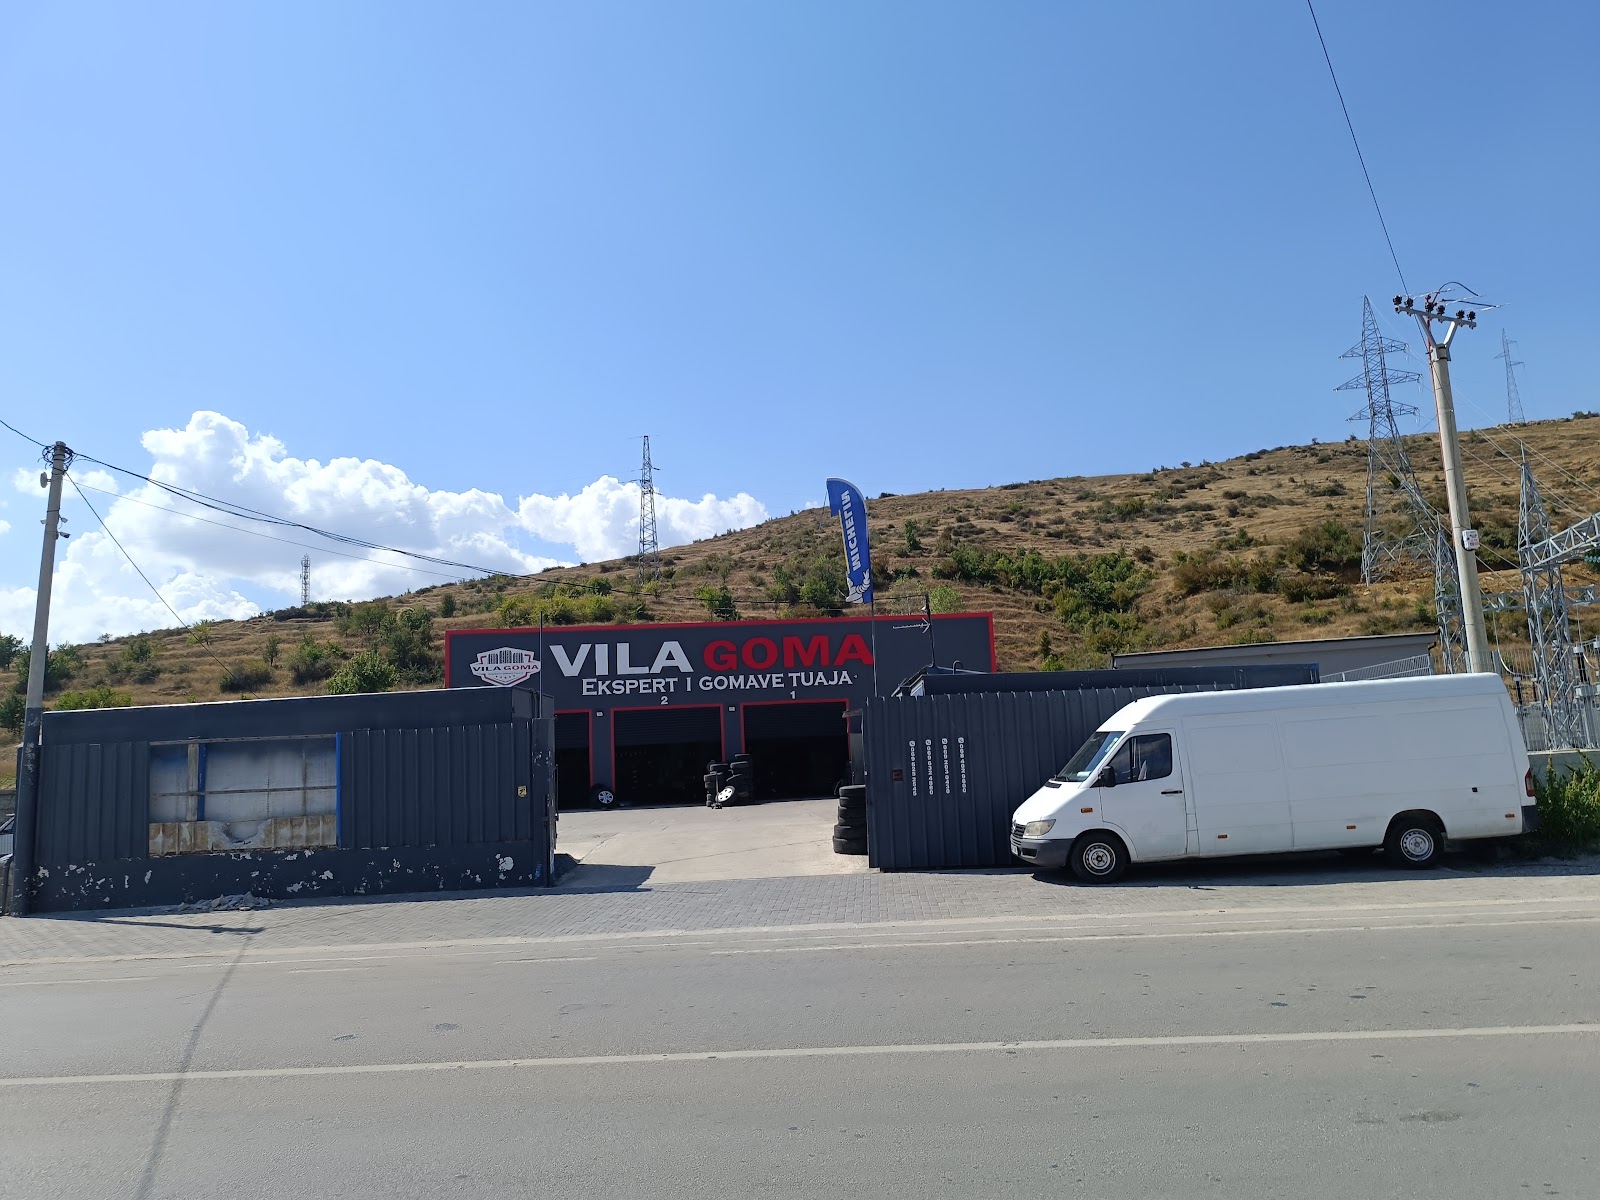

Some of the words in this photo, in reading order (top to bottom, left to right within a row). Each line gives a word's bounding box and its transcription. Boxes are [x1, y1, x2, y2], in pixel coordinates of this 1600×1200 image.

[548, 640, 694, 678] VILA
[703, 632, 875, 673] GOMA
[581, 676, 678, 697] EKSPERT
[686, 675, 693, 693] I
[698, 672, 785, 691] GOMAVE
[788, 669, 853, 688] TUAJA
[660, 695, 669, 705] 2
[790, 690, 796, 700] 1
